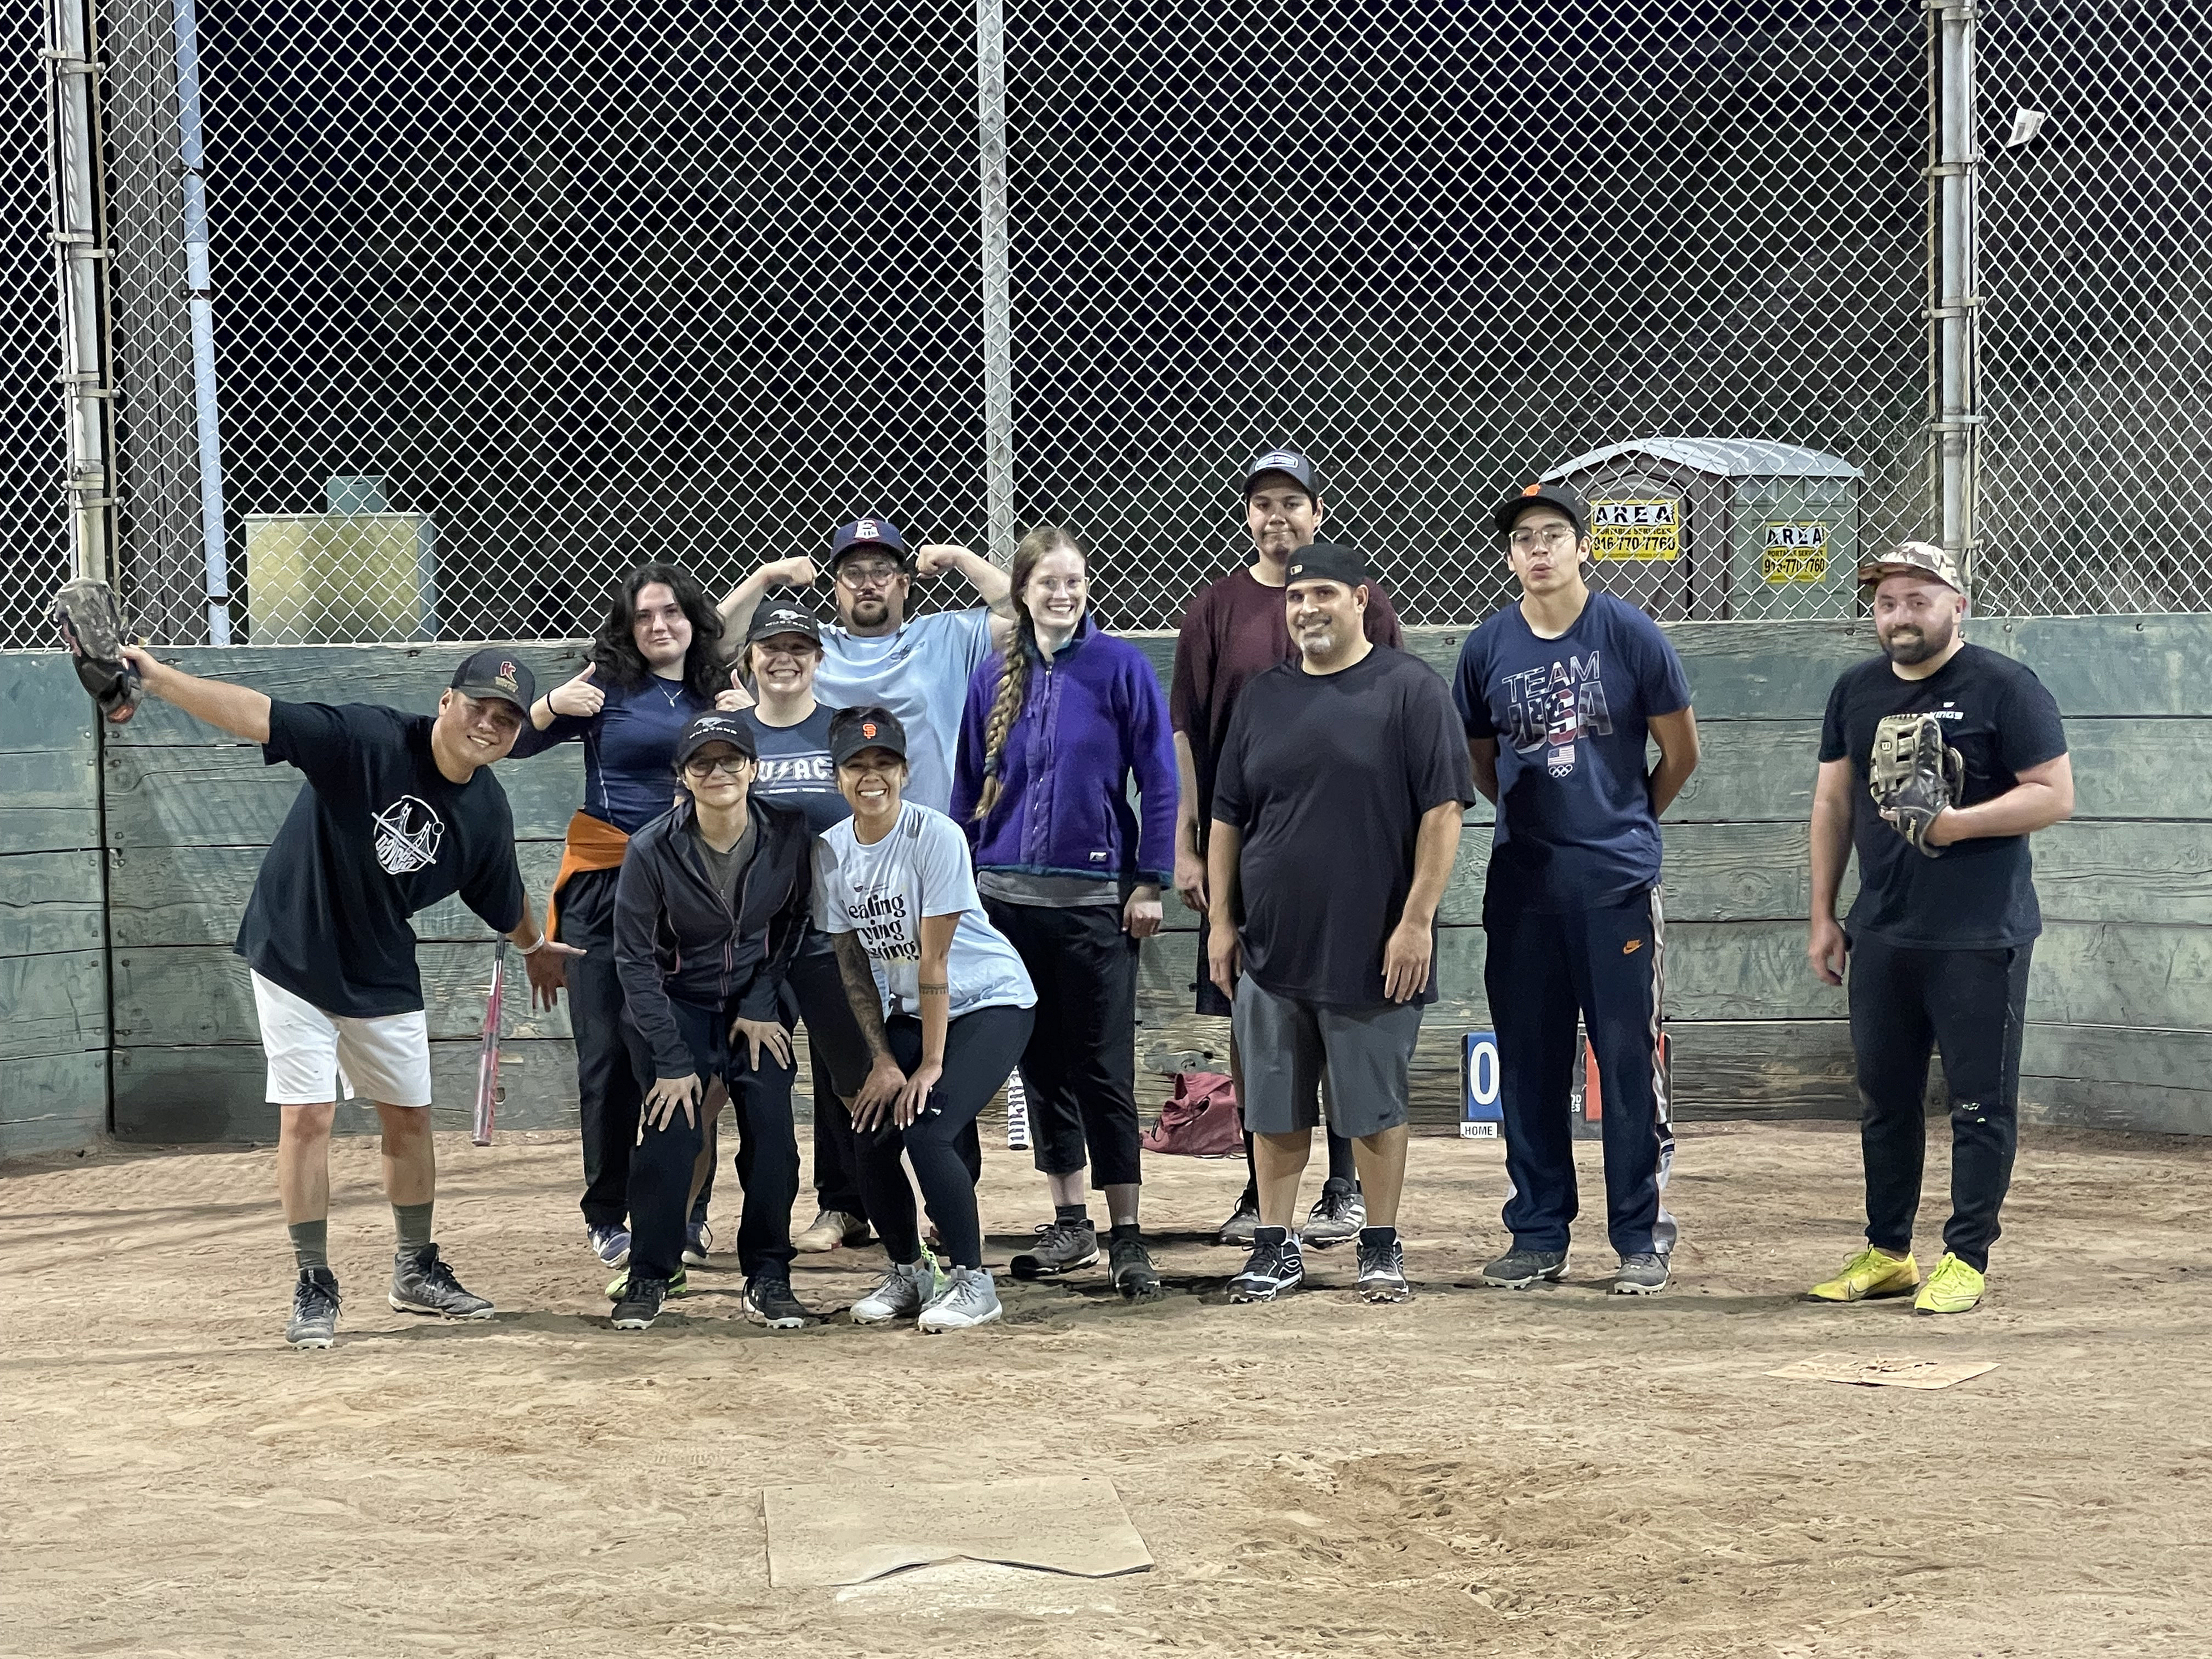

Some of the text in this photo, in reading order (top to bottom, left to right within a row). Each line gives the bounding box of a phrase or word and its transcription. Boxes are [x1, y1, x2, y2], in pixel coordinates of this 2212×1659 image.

[1595, 506, 1672, 523] AREA
[1766, 528, 1822, 545] AREA
[1502, 650, 1600, 703] TEAM
[1508, 681, 1613, 754] USA
[848, 894, 907, 919] ealing
[1470, 1041, 1500, 1105] 0
[1465, 1126, 1493, 1136] HOME
